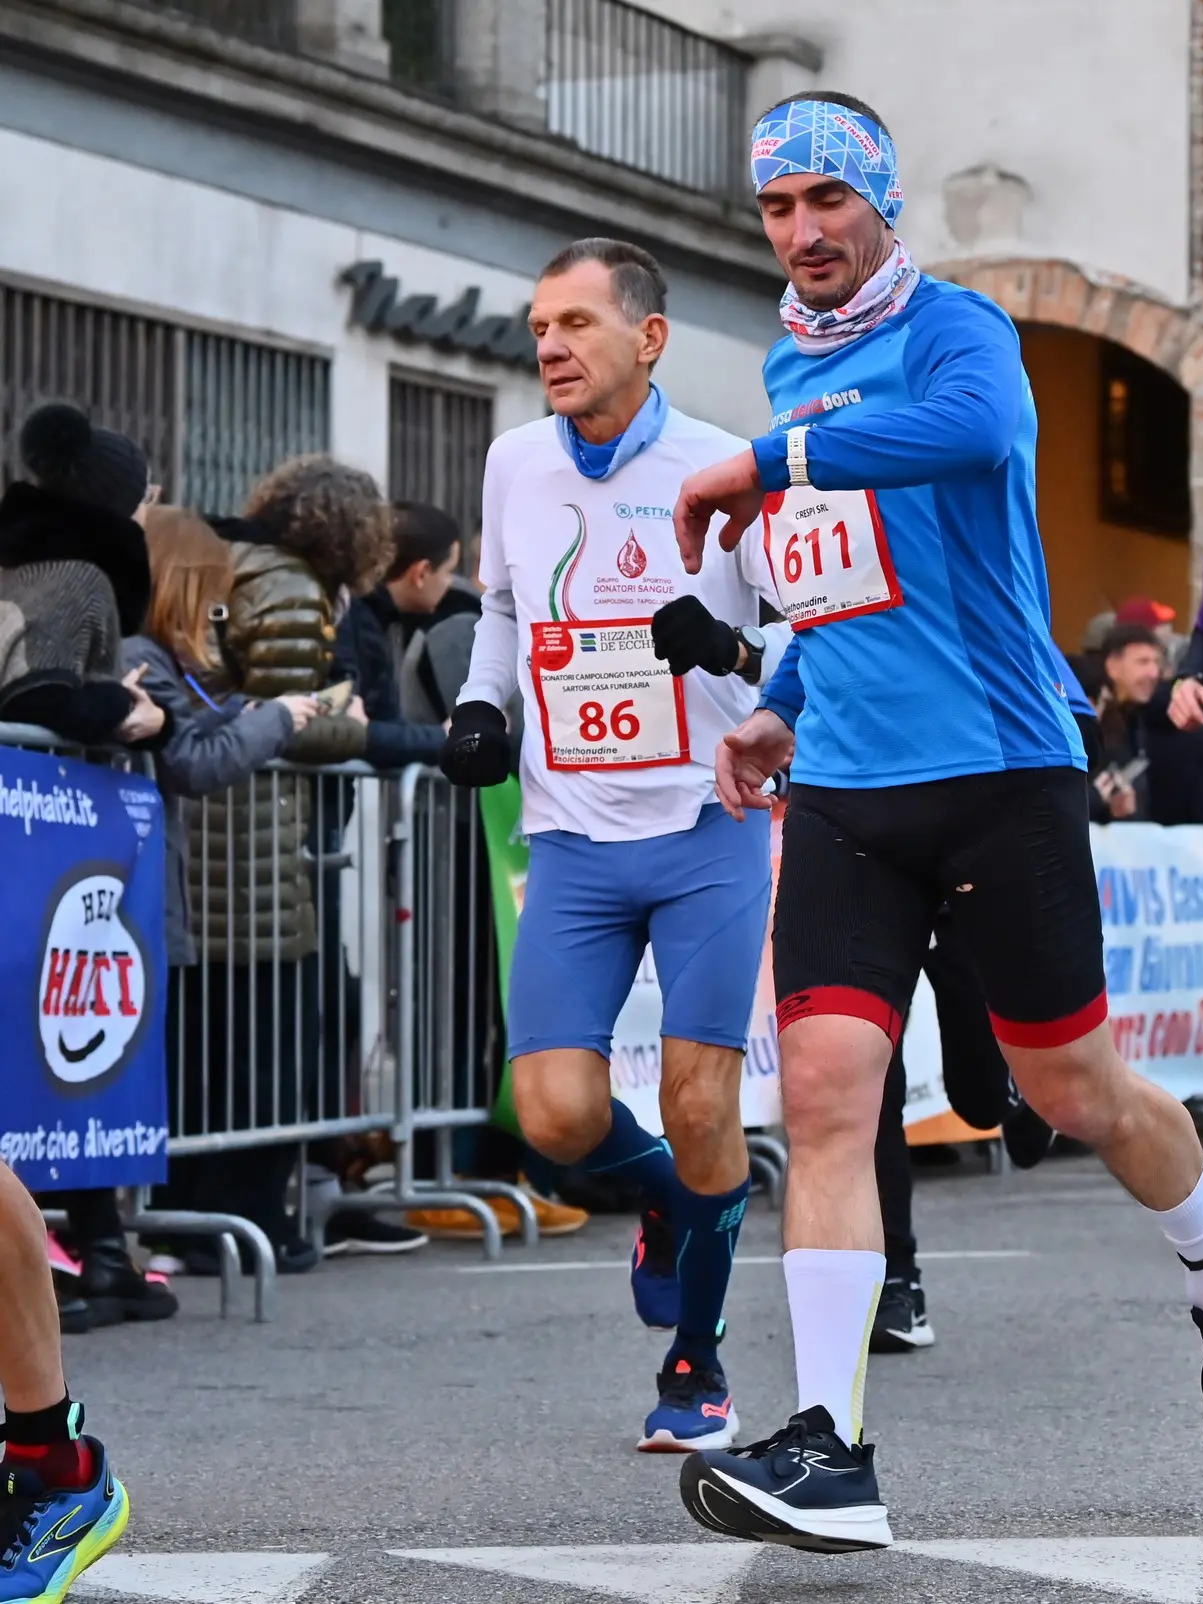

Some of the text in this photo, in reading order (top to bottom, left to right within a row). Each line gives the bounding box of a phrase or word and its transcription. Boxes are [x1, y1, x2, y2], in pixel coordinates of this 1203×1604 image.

[834, 115, 874, 159] DE INFANTI
[864, 135, 880, 156] RUDI
[795, 502, 829, 520] CRESPI SRL
[784, 520, 852, 584] 611
[593, 585, 675, 594] DONATORI SANGUE
[643, 577, 672, 585] SPORTIVO
[599, 629, 648, 642] RIZZANI
[600, 641, 616, 652] DE
[541, 668, 672, 682] DONATORI CAMPOLONGO TAPOGLIANO
[562, 681, 650, 693] SARTORI CASA FUNERARIA
[578, 699, 640, 742] 86
[47, 1119, 80, 1161] che
[35, 1532, 55, 1556] BROOKS
